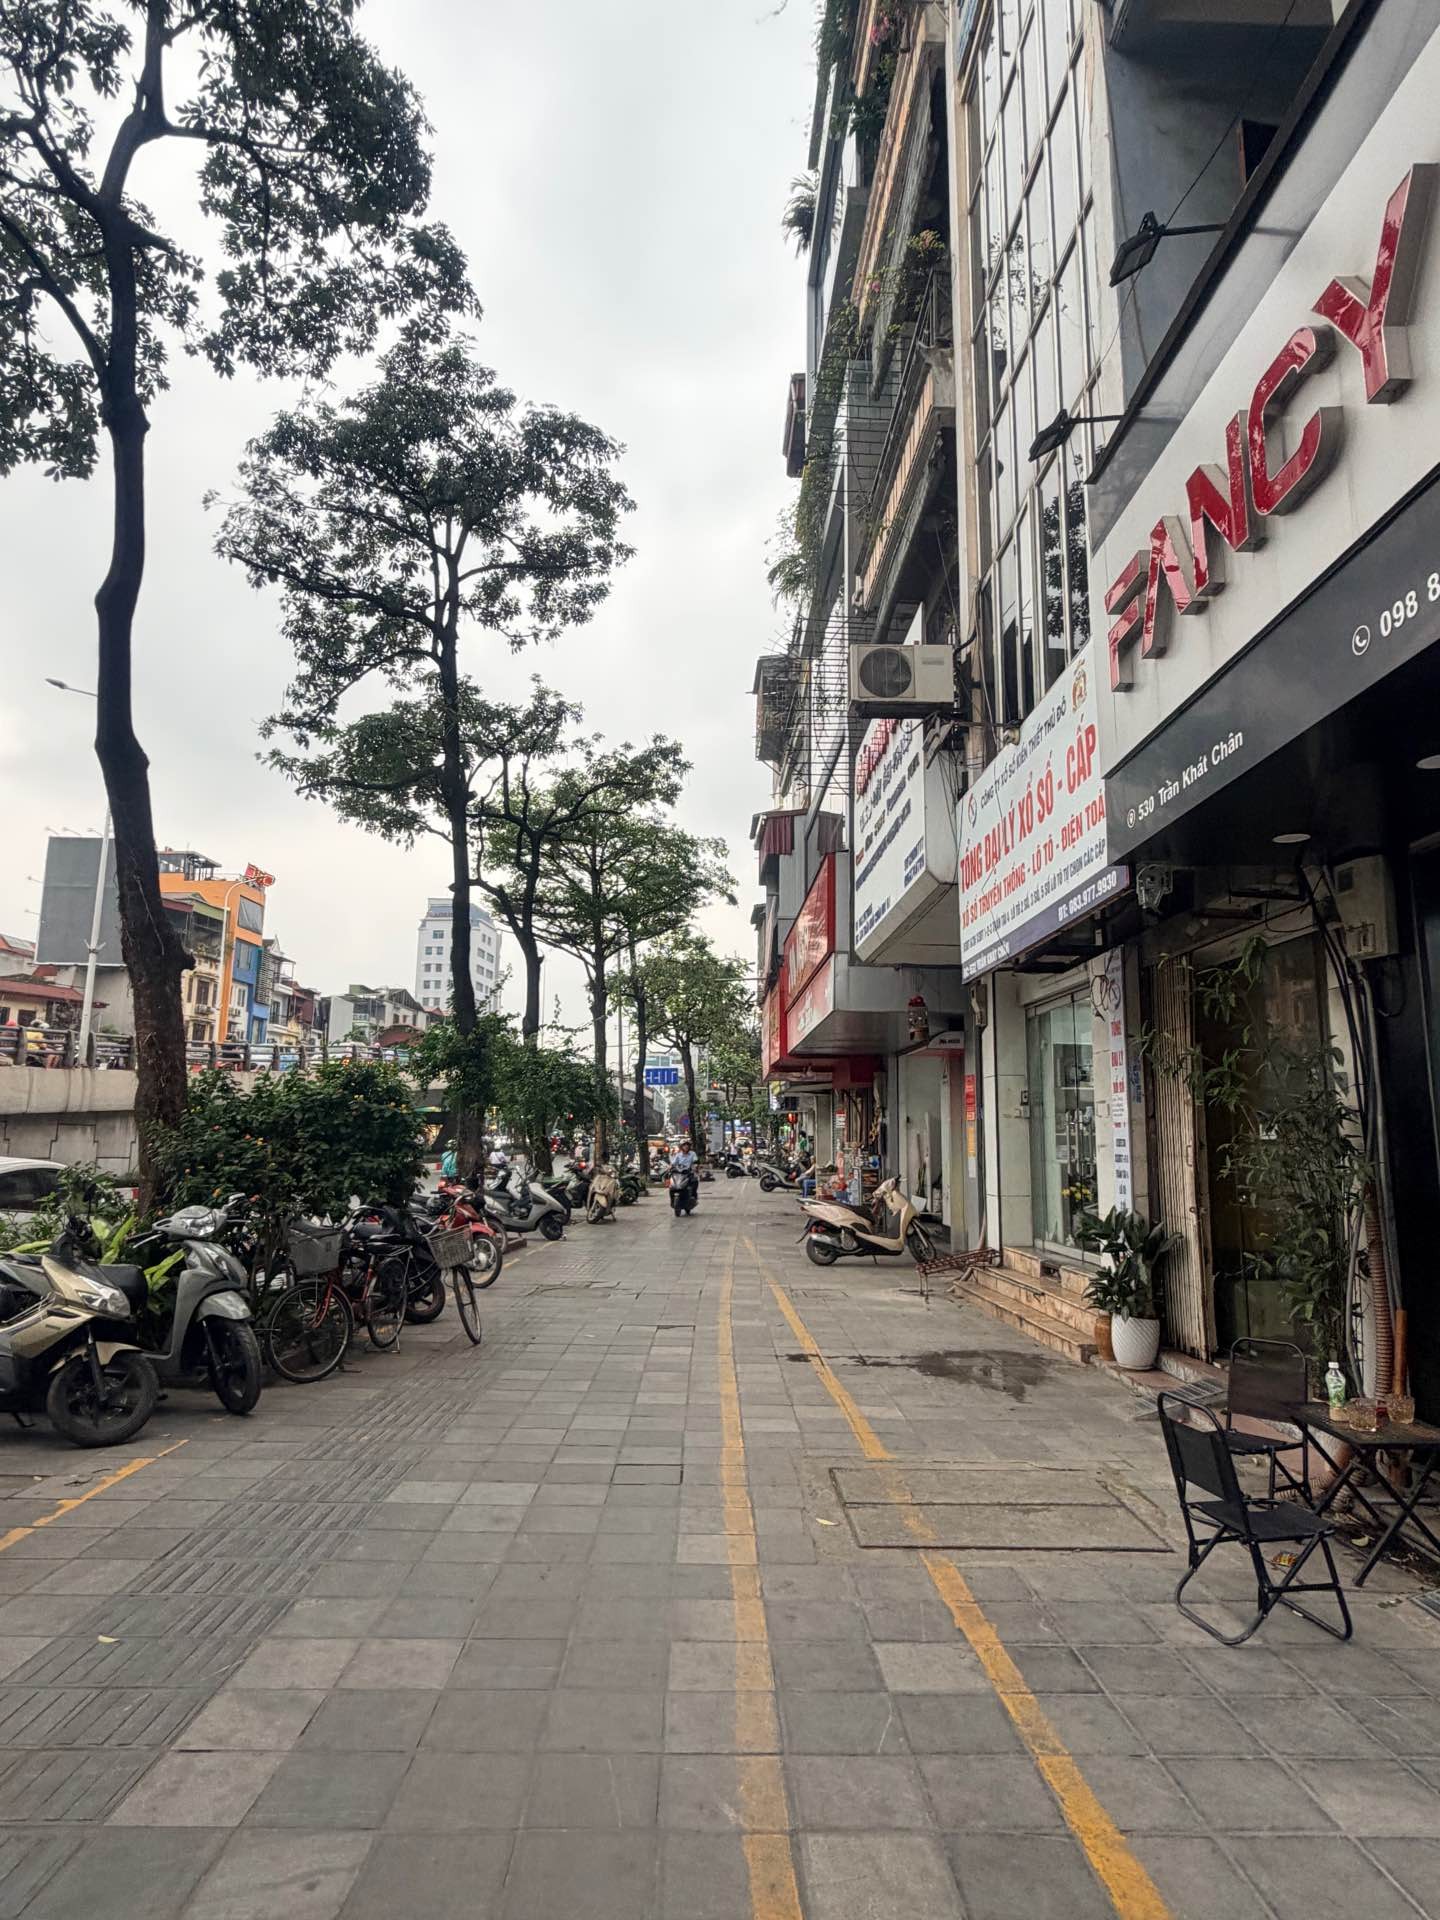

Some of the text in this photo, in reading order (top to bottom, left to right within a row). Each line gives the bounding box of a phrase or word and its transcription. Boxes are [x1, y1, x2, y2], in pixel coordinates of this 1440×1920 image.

[1104, 164, 1428, 692] FANCY
[1379, 590, 1418, 637] 098
[960, 838, 983, 894] TỔNG
[984, 822, 1001, 875] ĐẠI
[1002, 800, 1016, 855] LÝ
[1018, 771, 1034, 842] XỔ
[1037, 750, 1054, 824] SỐ
[1066, 712, 1097, 794] CẤP
[1138, 731, 1244, 821] 530 Trần Khát Chân
[1061, 813, 1083, 852] ĐIỆN
